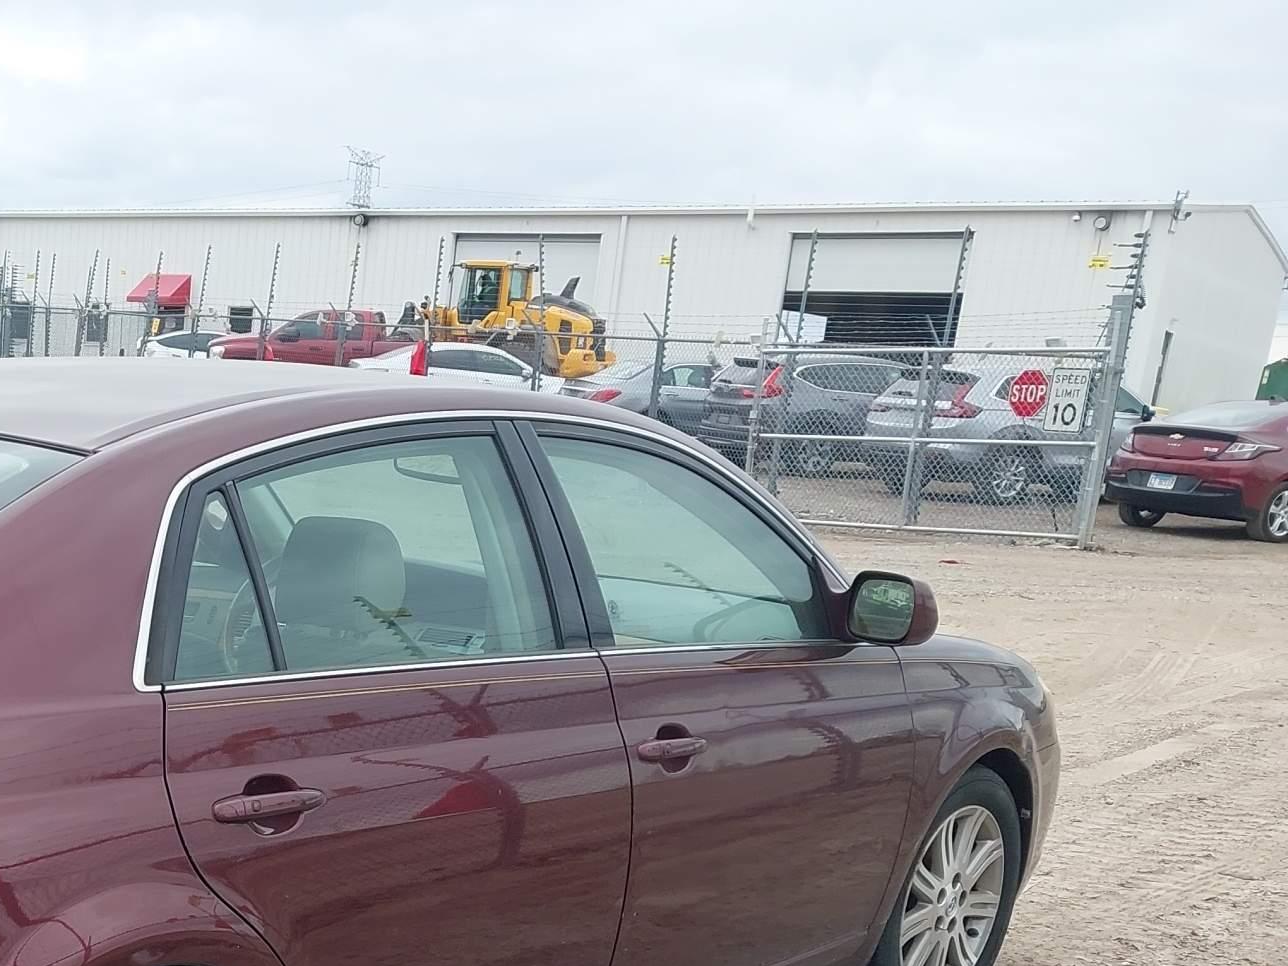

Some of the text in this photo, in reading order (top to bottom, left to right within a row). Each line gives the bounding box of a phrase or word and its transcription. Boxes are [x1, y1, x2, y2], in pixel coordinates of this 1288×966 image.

[1055, 374, 1087, 385] SPEED
[1011, 384, 1046, 403] STOP
[1055, 388, 1081, 398] LIMIT
[1052, 403, 1076, 426] 10
